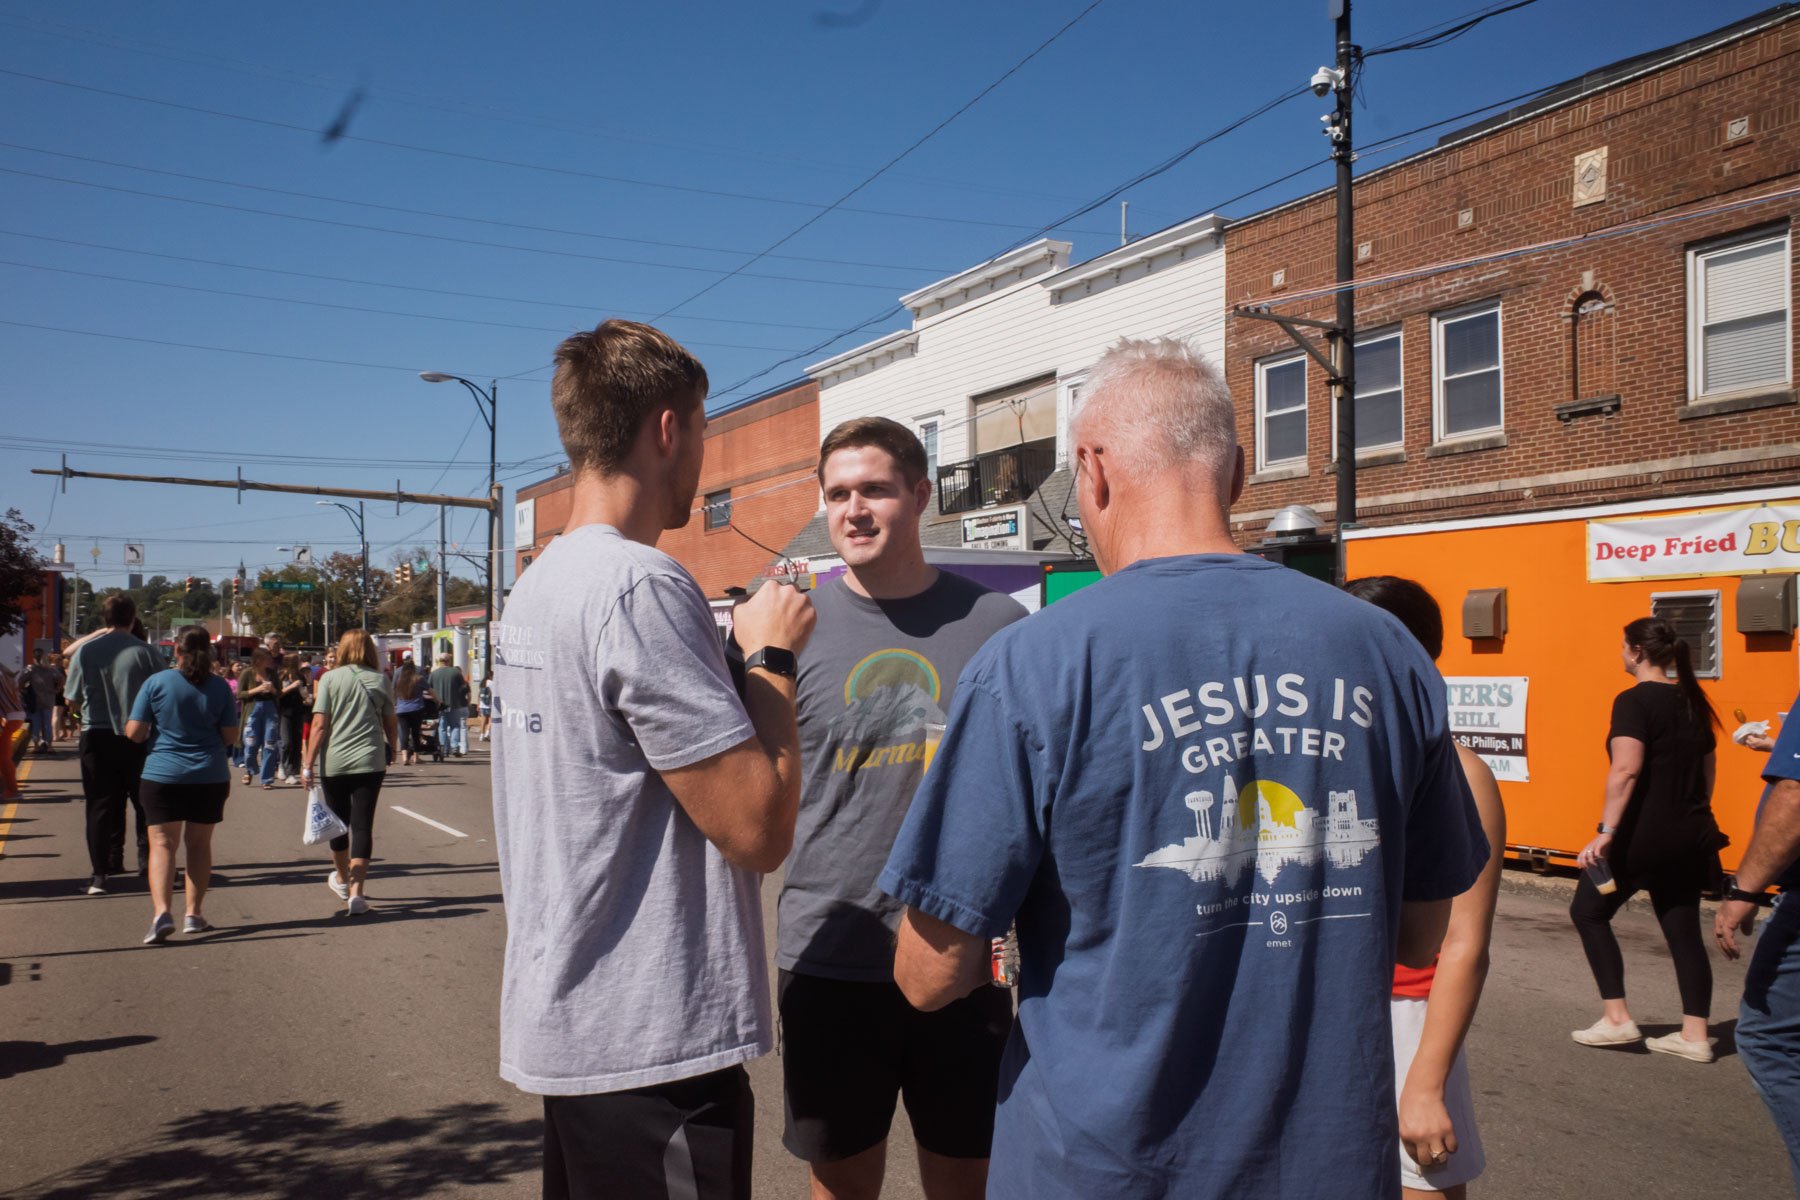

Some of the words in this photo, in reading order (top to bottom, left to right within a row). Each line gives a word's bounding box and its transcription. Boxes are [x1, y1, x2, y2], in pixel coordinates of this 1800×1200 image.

[1596, 543, 1656, 562] Deep
[1663, 532, 1737, 556] Fried
[1142, 673, 1309, 751] JESUS
[1332, 678, 1374, 729] IS
[1454, 711, 1500, 728] HILL
[1181, 727, 1346, 774] GREATER
[1511, 737, 1523, 750] IN
[1196, 902, 1222, 916] turn
[1224, 896, 1239, 910] the
[1242, 891, 1270, 906] city
[1275, 889, 1319, 906] upside
[1322, 886, 1363, 898] down
[1266, 939, 1292, 948] emet
